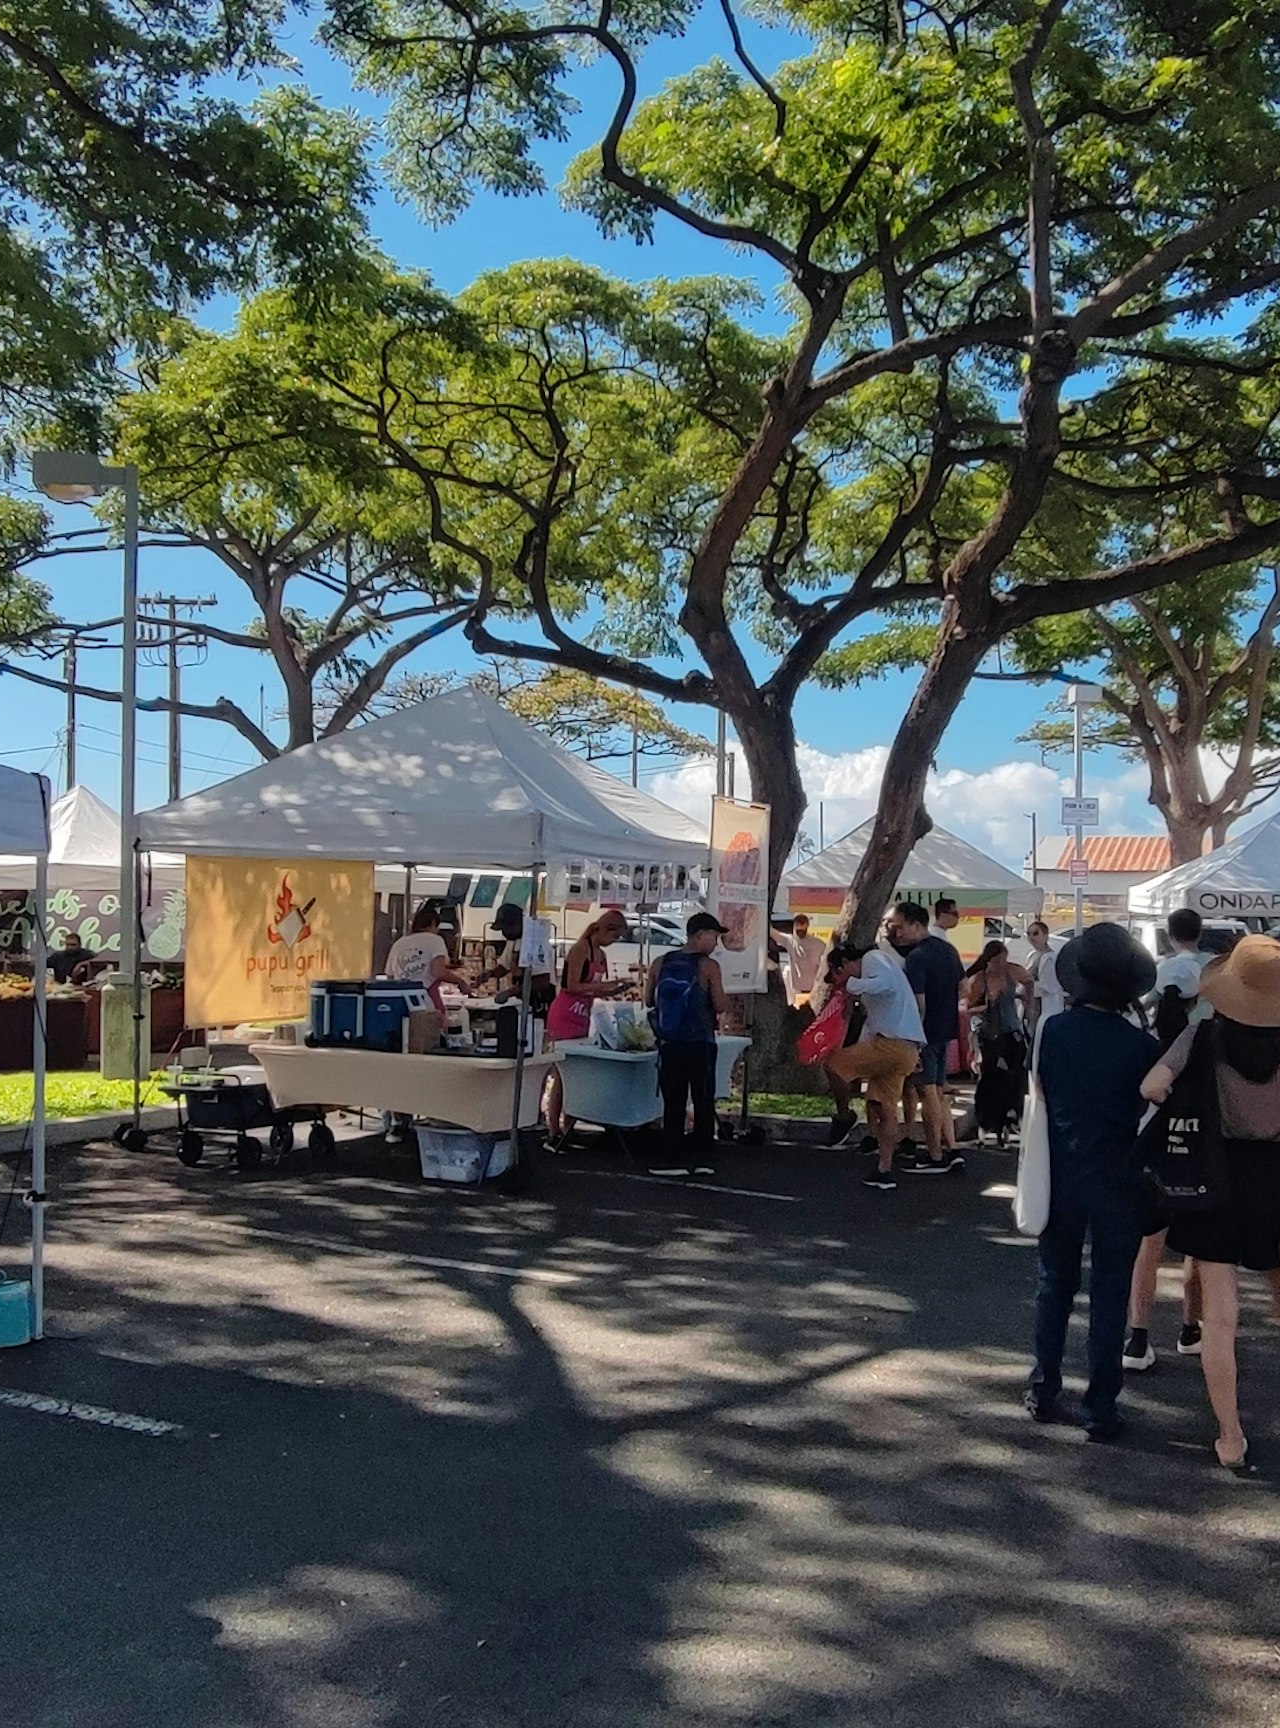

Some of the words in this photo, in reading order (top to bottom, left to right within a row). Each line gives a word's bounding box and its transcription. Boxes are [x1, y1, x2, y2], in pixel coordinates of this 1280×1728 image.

[99, 894, 121, 915] o
[894, 891, 945, 906] AFFLE
[246, 955, 288, 980] pupu
[296, 948, 329, 977] grill
